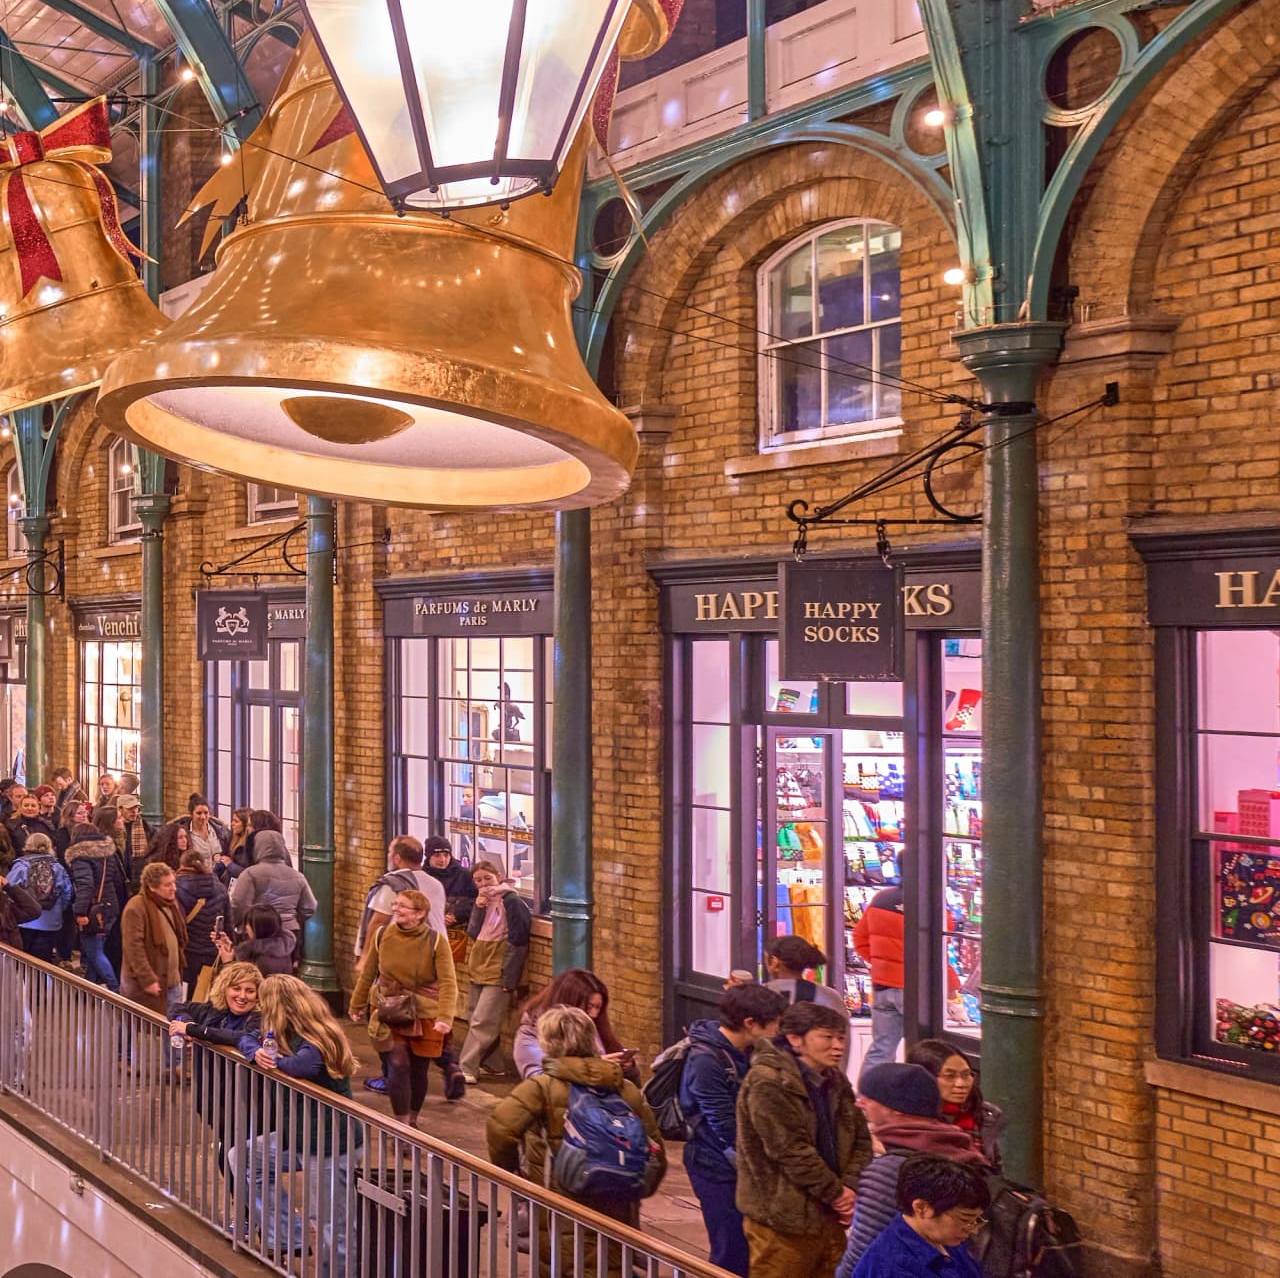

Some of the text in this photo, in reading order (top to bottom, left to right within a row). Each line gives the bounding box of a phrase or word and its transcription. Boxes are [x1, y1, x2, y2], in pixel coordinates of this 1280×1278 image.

[274, 609, 306, 620] MARLY
[415, 599, 537, 615] PARFUMS de MARLY
[804, 602, 882, 619] HAPPY
[97, 614, 139, 637] Venchi
[460, 616, 487, 626] PARIS
[804, 626, 880, 643] SOCKS
